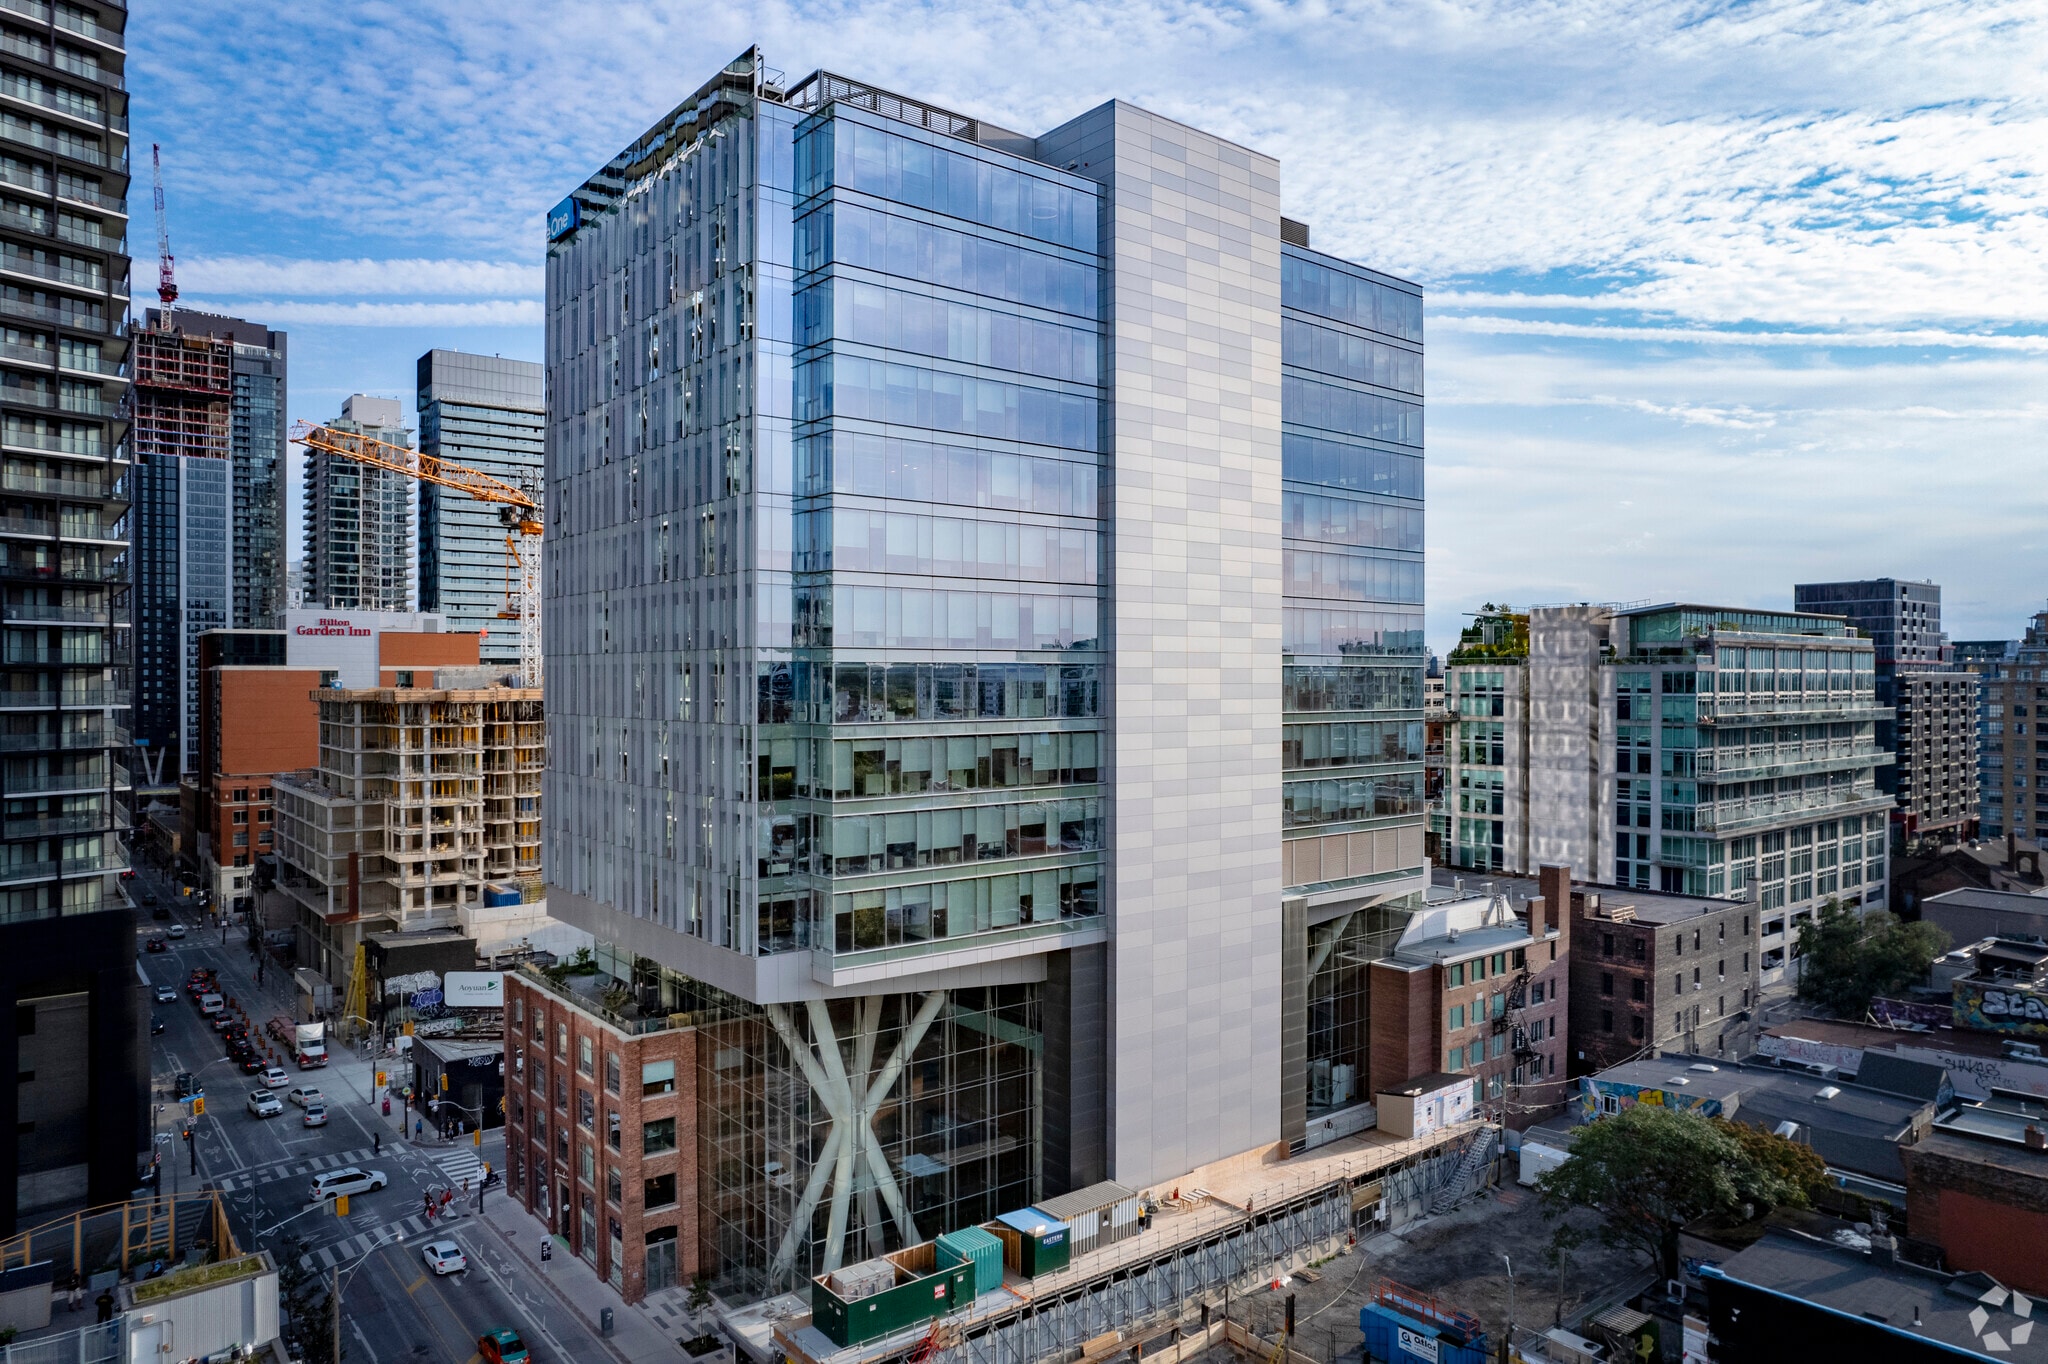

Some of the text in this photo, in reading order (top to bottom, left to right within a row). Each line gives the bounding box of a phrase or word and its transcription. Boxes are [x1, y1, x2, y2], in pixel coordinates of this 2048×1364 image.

[319, 618, 350, 626] Hilton
[296, 625, 371, 636] Garden Inn
[459, 984, 487, 993] Aoyuan
[1414, 1336, 1437, 1352] atlas
